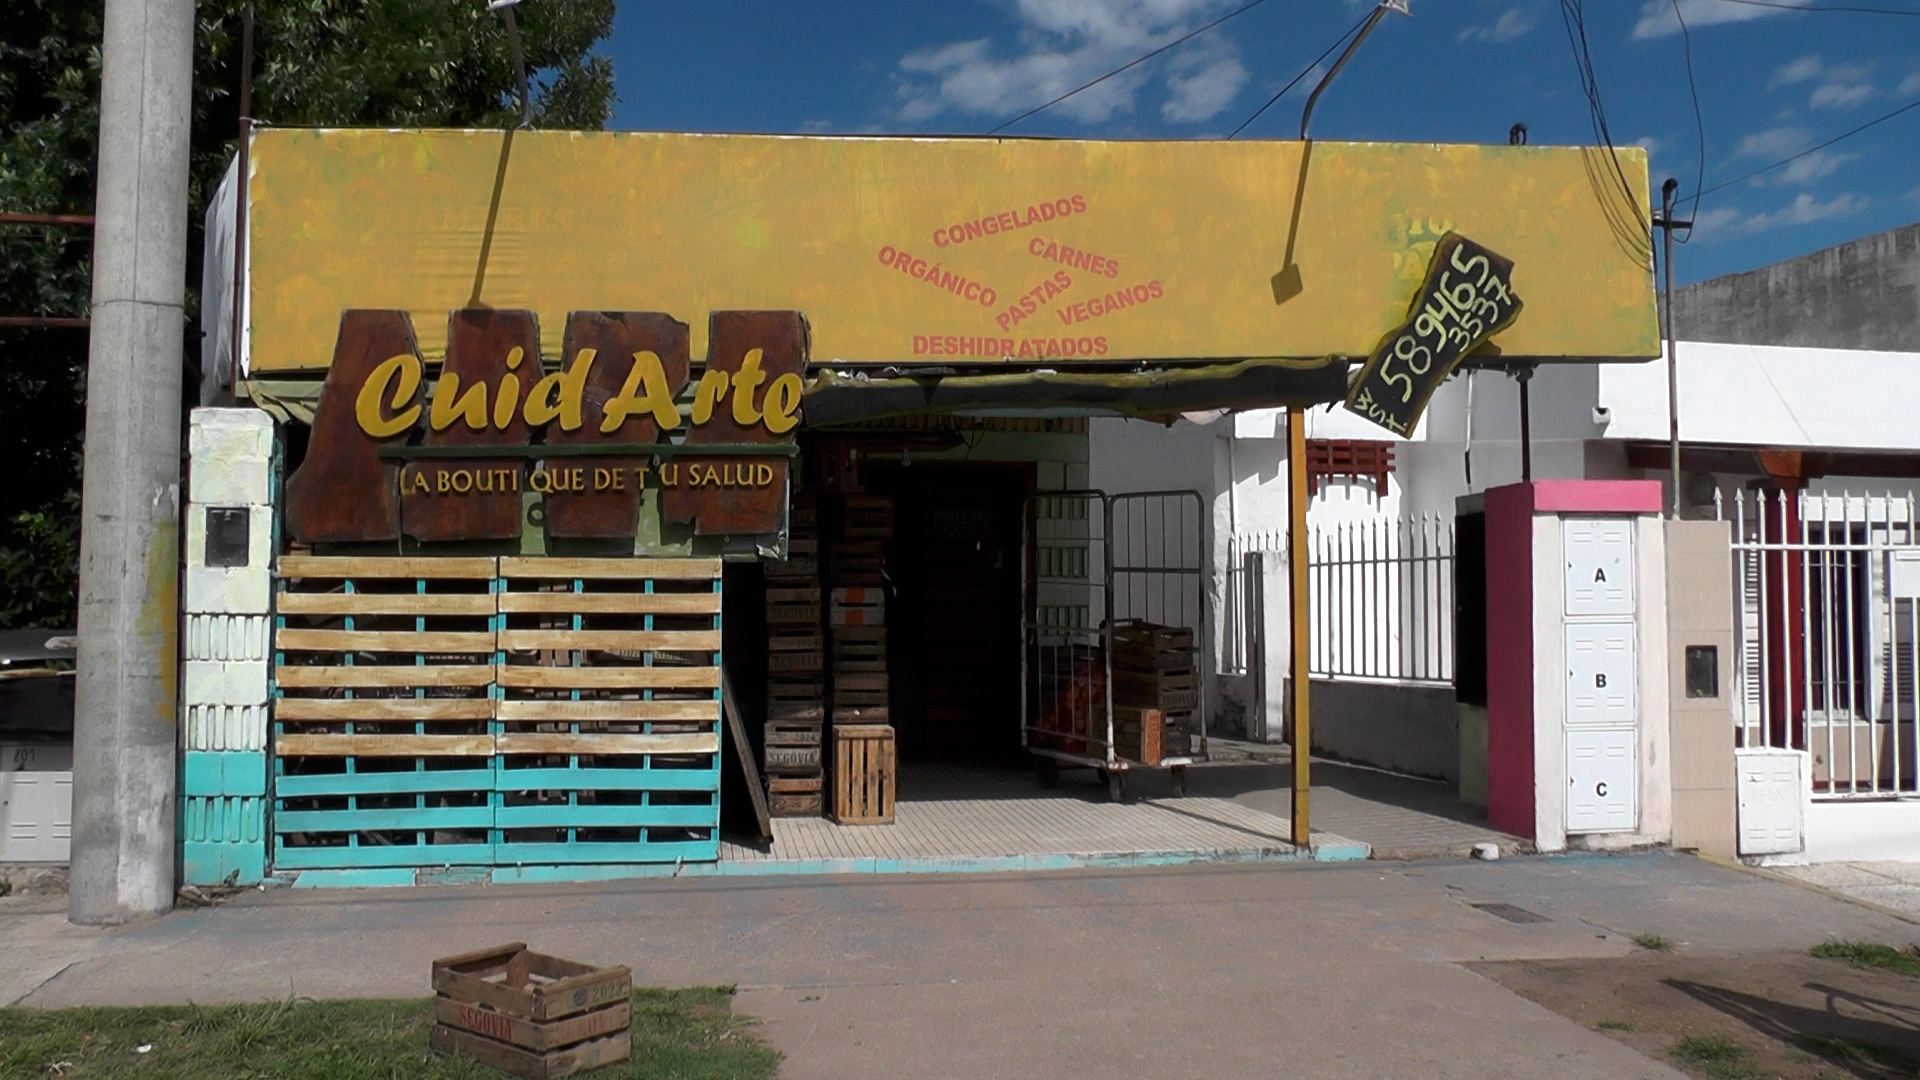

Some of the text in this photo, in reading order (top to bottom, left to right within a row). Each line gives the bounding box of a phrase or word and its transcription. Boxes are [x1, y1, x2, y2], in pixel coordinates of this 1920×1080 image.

[932, 194, 1087, 248] CONGELADOS
[1028, 237, 1120, 279] CARNES
[877, 245, 997, 308] ORGÁNICO
[994, 270, 1072, 333] PASTAS
[1056, 280, 1164, 326] VEGANOS
[1448, 274, 1512, 352] 3537
[912, 335, 1109, 358] DESHIDRATADOS
[400, 467, 431, 495] LA
[594, 467, 624, 490] DE
[689, 463, 773, 486] SALUD
[1594, 567, 1607, 583] A
[1595, 674, 1607, 689] B
[769, 750, 816, 765] SEGOVIA
[1596, 781, 1608, 797] C
[459, 1005, 512, 1041] SEGOVIA
